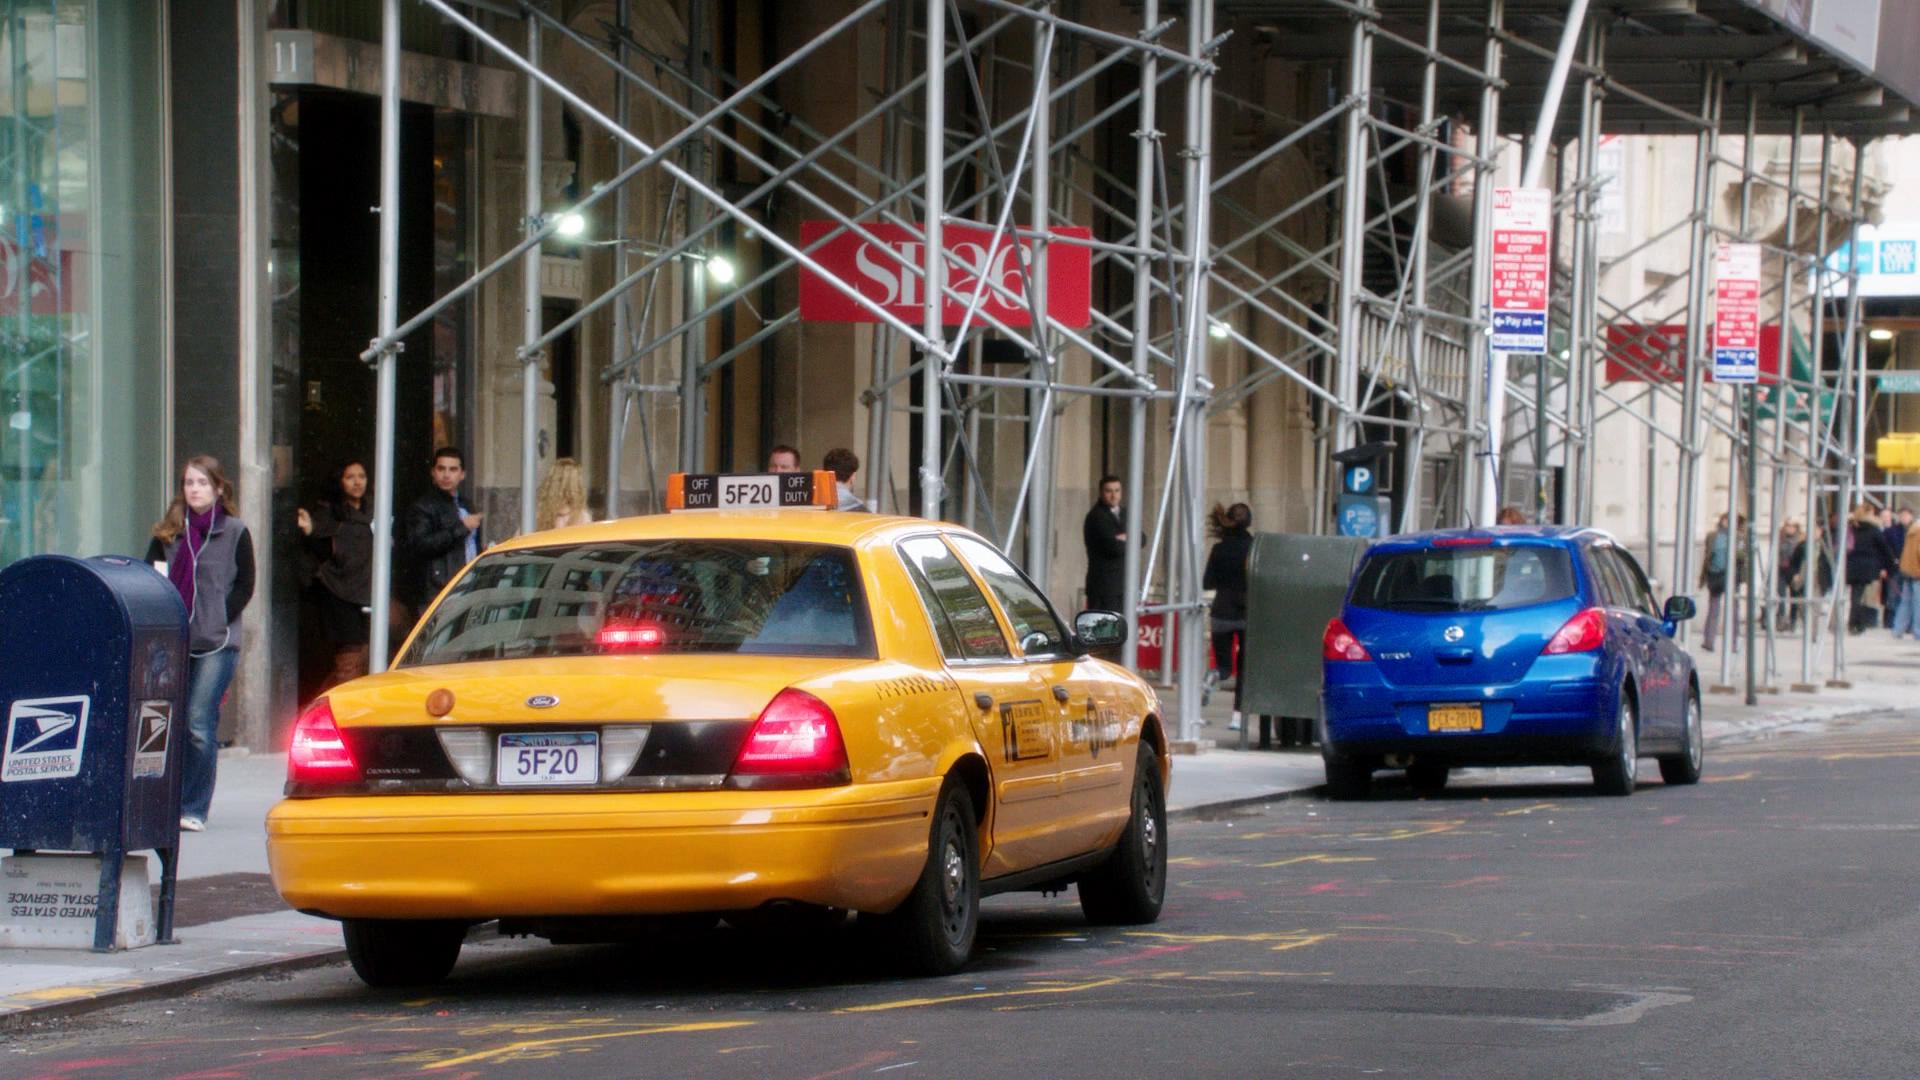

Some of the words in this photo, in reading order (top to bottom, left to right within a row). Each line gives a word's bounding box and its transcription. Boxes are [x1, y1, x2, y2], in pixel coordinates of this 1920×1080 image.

[1505, 316, 1521, 328] Pay
[691, 478, 709, 490] OFF
[787, 476, 805, 488] OFF
[1353, 467, 1371, 492] P
[688, 493, 712, 505] DUTY
[725, 484, 772, 505] 5F20
[785, 491, 808, 503] DUTY
[8, 757, 42, 767] UNITED
[42, 755, 72, 765] STATES
[517, 748, 578, 775] 5F20
[7, 766, 38, 777] POSTAL
[40, 764, 75, 774] SERVICE
[8, 892, 59, 904] SERVICE
[62, 894, 101, 905] OSTAL
[11, 906, 58, 917] STATES
